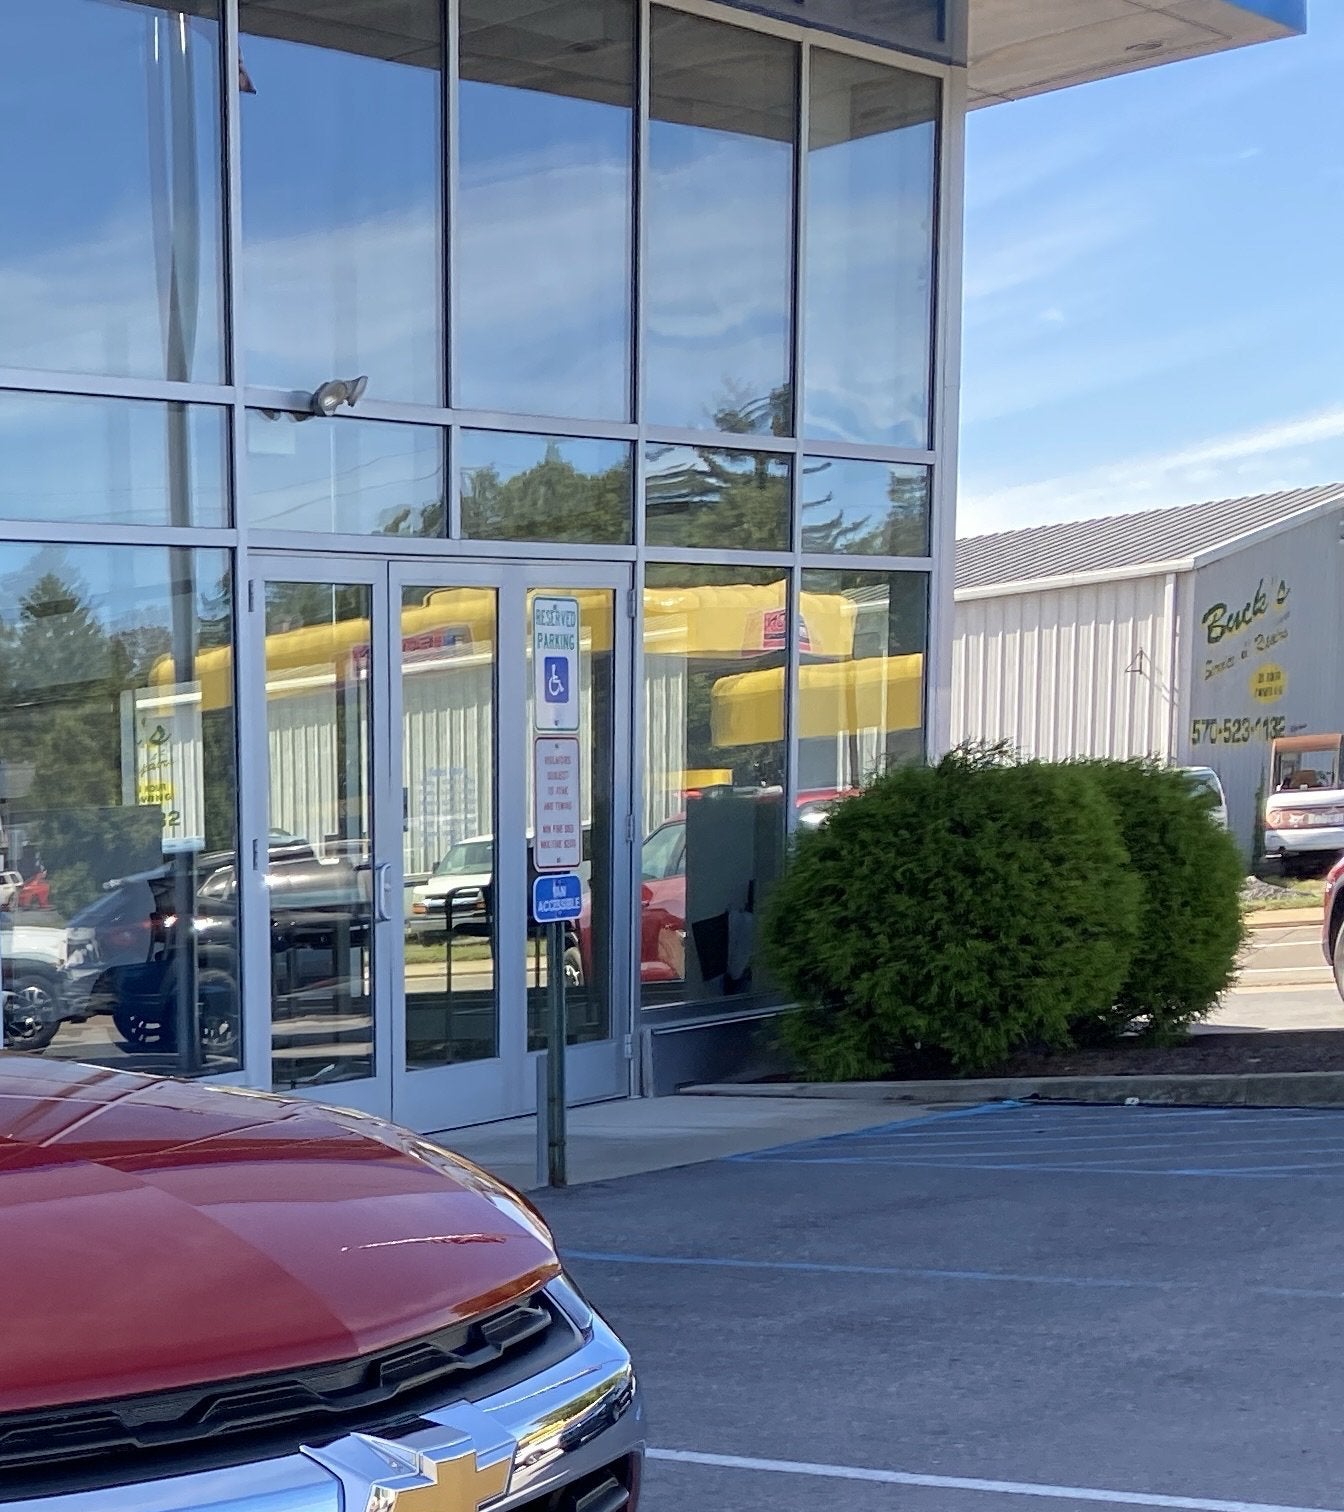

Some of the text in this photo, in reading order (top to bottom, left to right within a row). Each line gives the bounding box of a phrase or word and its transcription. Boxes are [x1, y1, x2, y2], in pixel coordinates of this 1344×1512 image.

[536, 608, 576, 627] RESERVED
[1201, 577, 1292, 645] Buck's
[537, 632, 575, 651] PARKING
[537, 897, 581, 912] ACCESSIBLE
